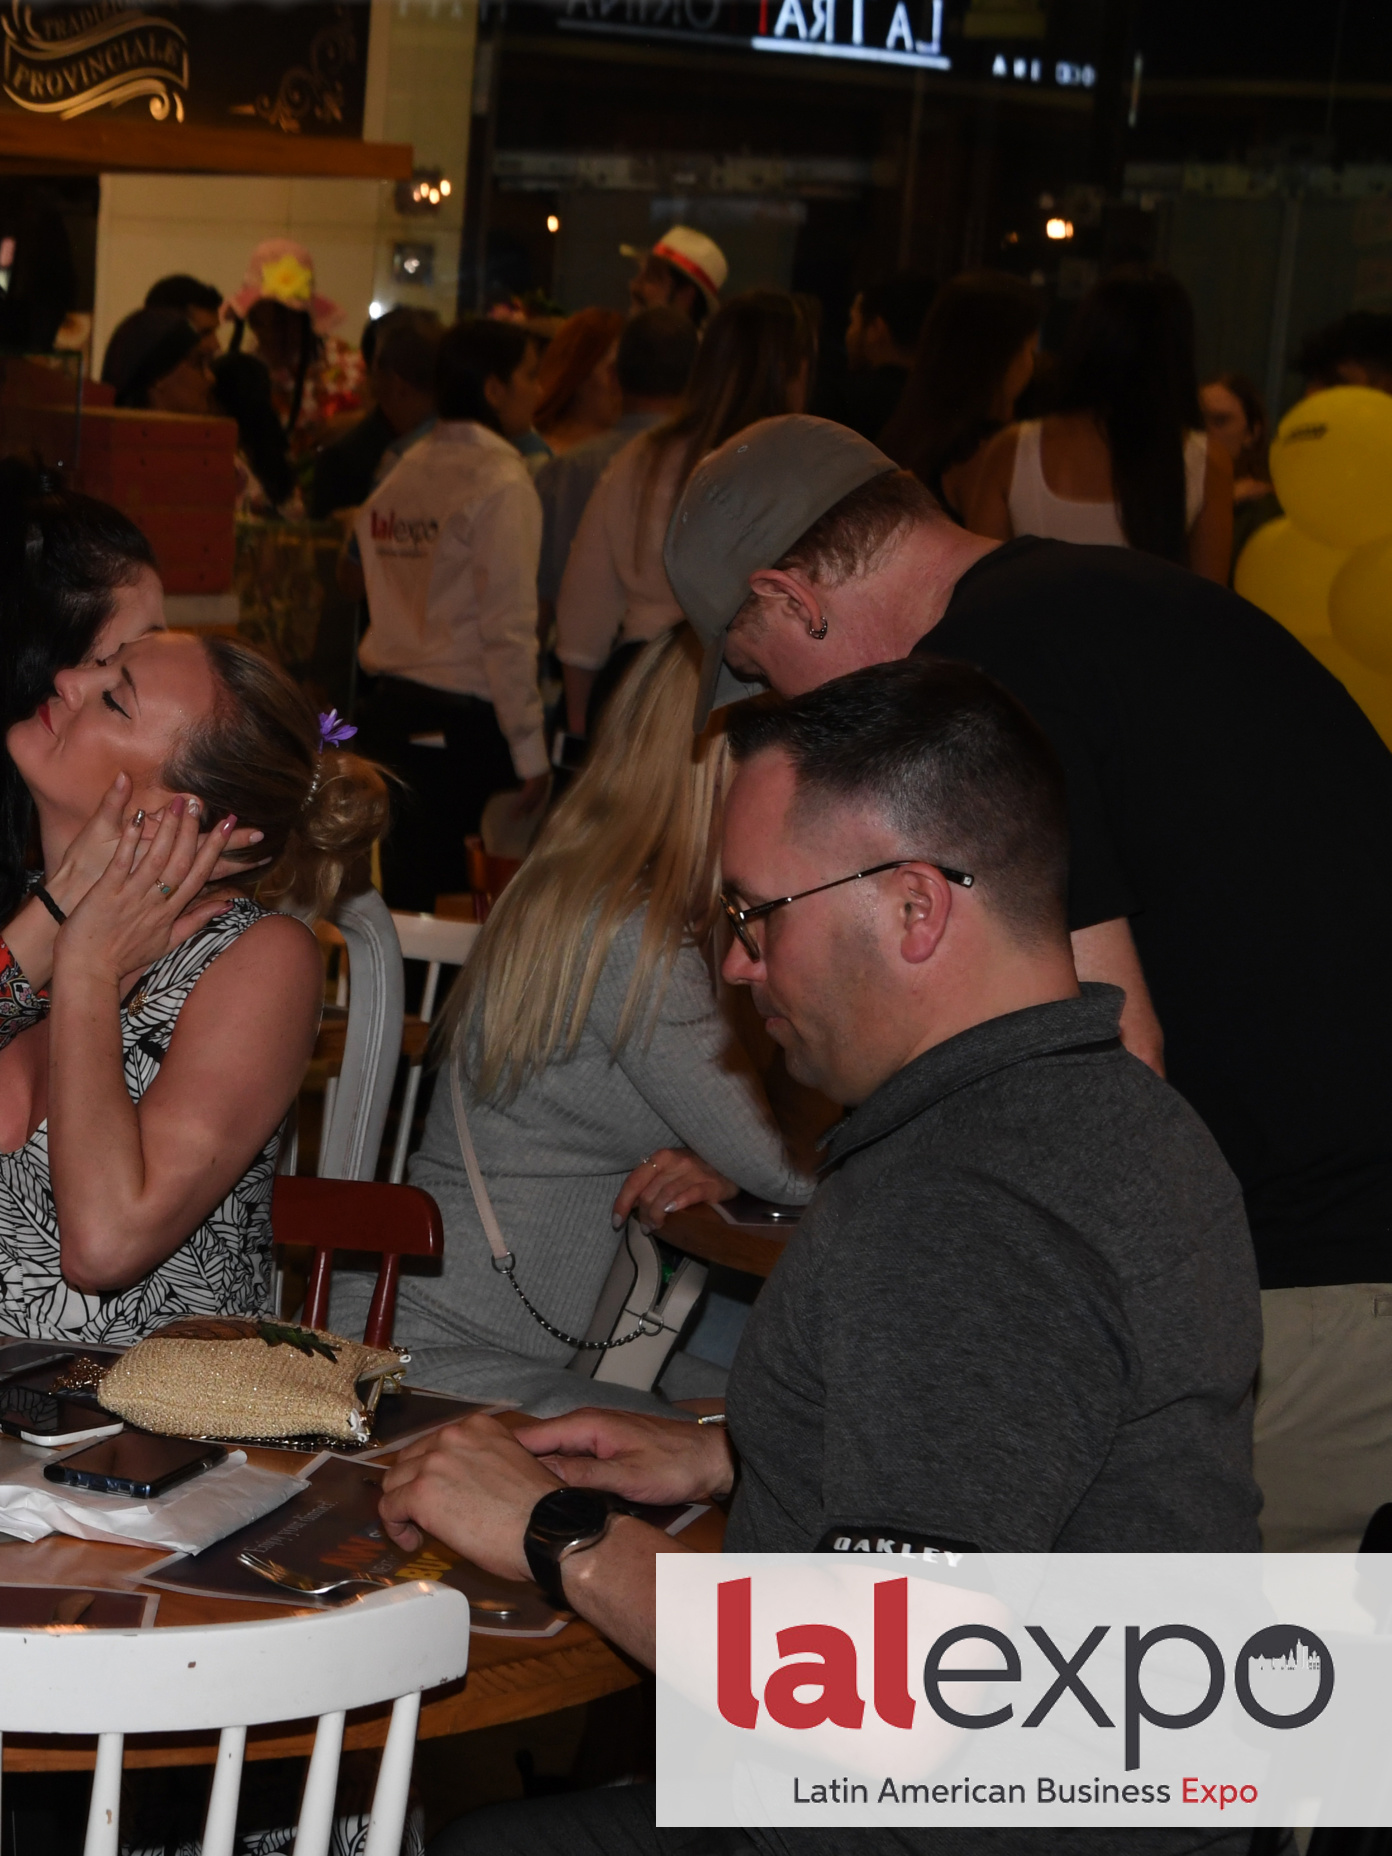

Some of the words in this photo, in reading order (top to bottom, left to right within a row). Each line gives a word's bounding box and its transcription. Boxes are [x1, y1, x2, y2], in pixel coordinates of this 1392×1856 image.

[11, 33, 181, 97] PROVINCIALE
[371, 509, 439, 545] lalexpo
[831, 1536, 966, 1570] OAKLEY
